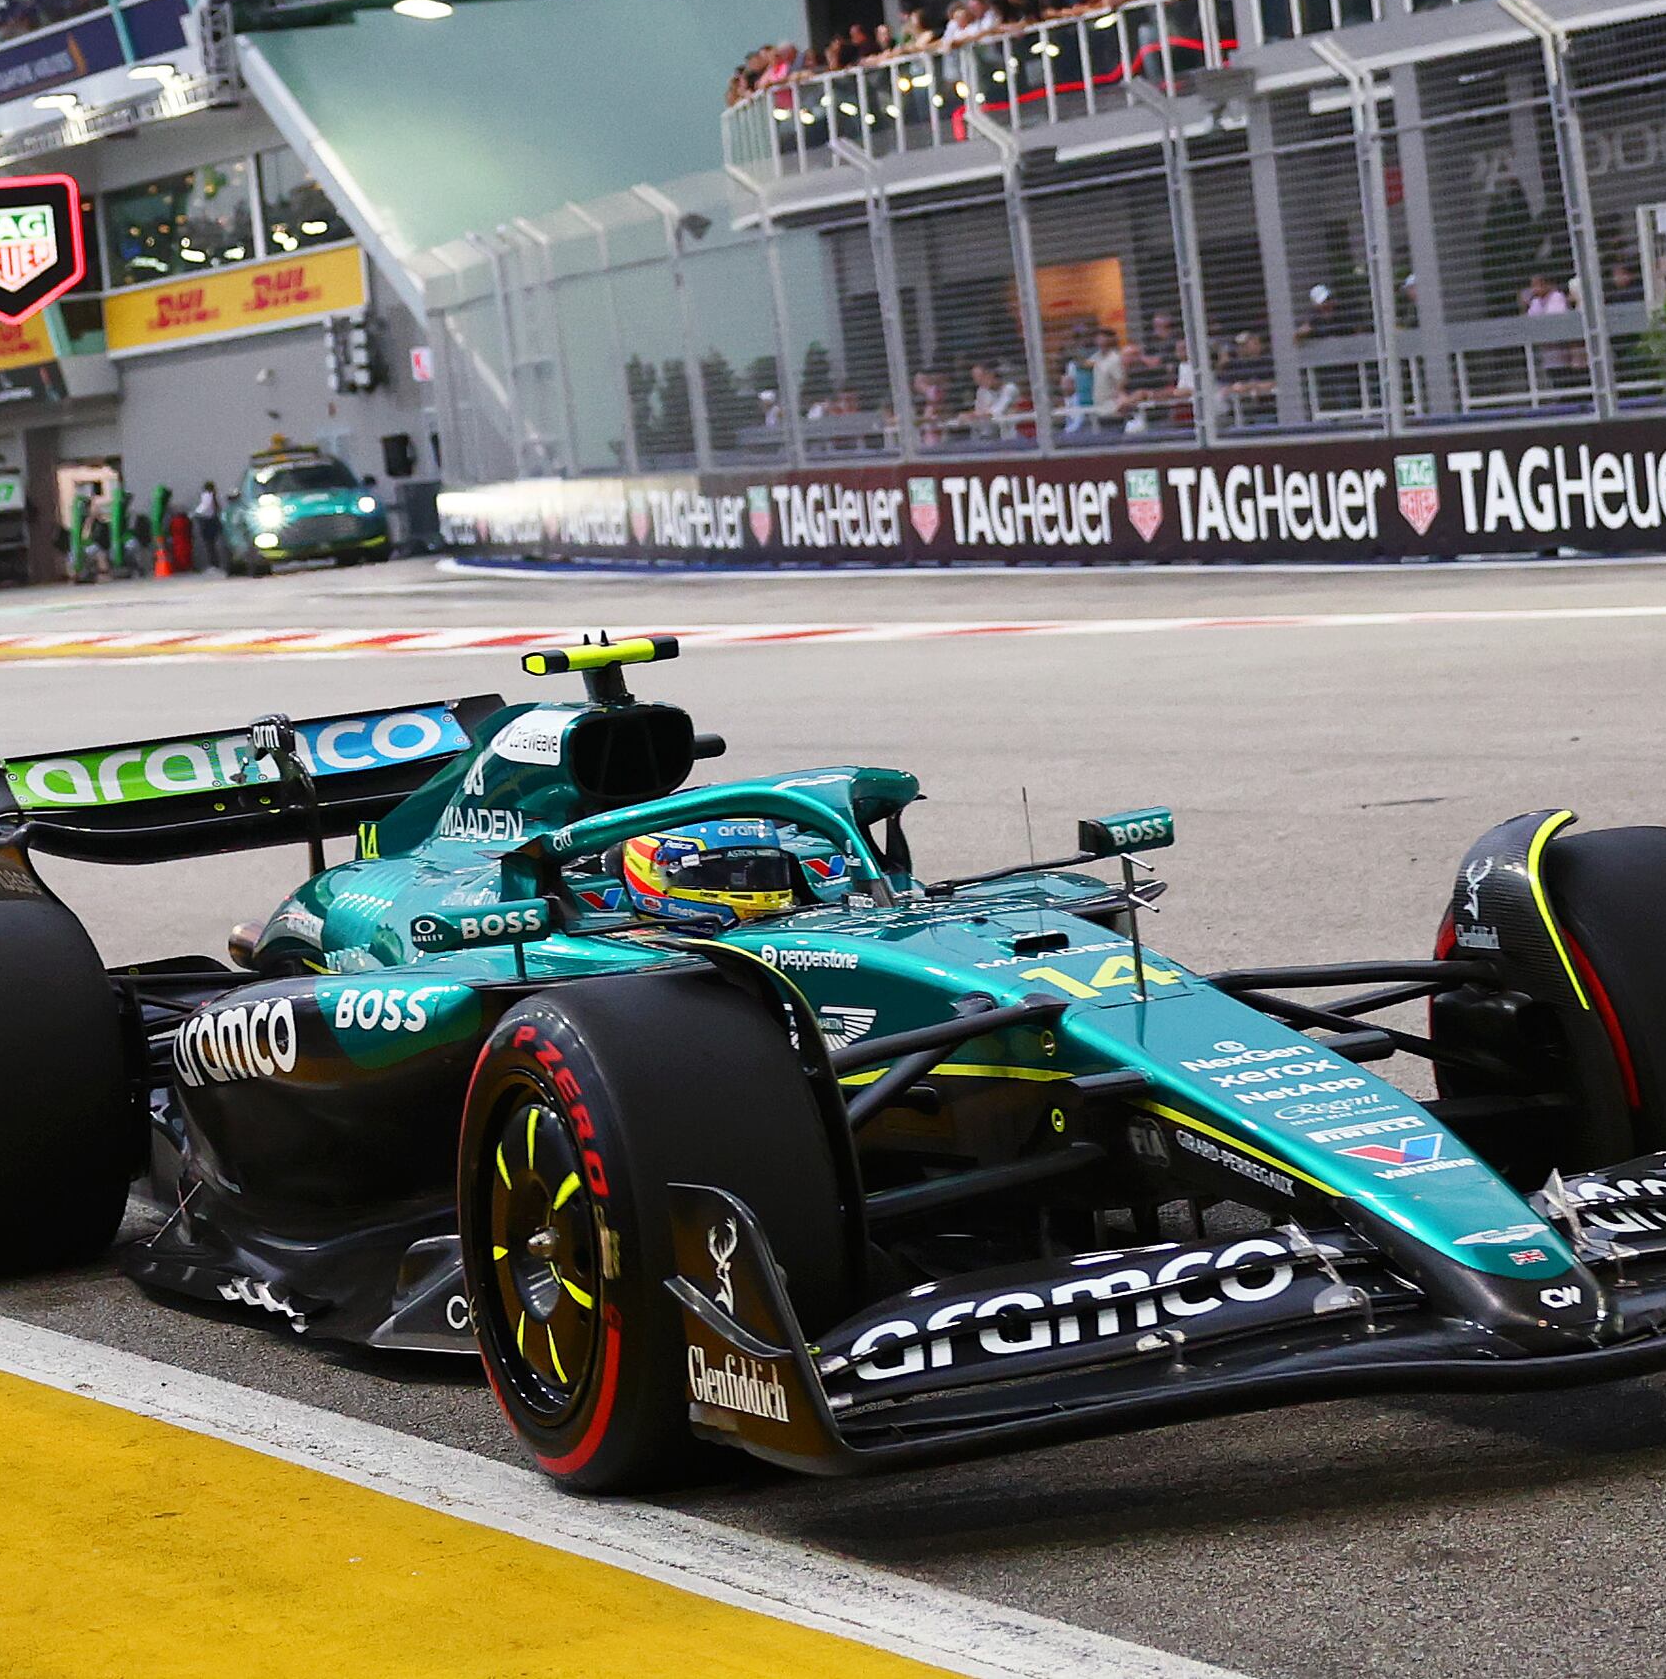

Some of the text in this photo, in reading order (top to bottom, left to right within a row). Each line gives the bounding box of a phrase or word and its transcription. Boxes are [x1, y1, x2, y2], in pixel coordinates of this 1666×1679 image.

[1396, 458, 1434, 486] TAG
[252, 723, 281, 750] arm
[440, 805, 523, 840] MAADEN
[1110, 818, 1167, 847] BOSS
[358, 823, 380, 860] 14
[460, 909, 542, 940] BOSS
[780, 949, 859, 971] pepperstone
[973, 941, 1135, 970] MAADEN
[1019, 954, 1184, 1000] 14
[334, 987, 431, 1033] BOSS
[173, 998, 298, 1089] aramco
[1181, 1044, 1316, 1072] NexGen
[1210, 1058, 1342, 1089] xerox
[1234, 1076, 1367, 1105] NetApp
[535, 1040, 610, 1198] ZERO
[1305, 1116, 1426, 1144] PIRELLI
[1373, 1157, 1479, 1180] Valvoline
[849, 1239, 1294, 1381] aramco
[687, 1343, 790, 1423] Glenfiddich
